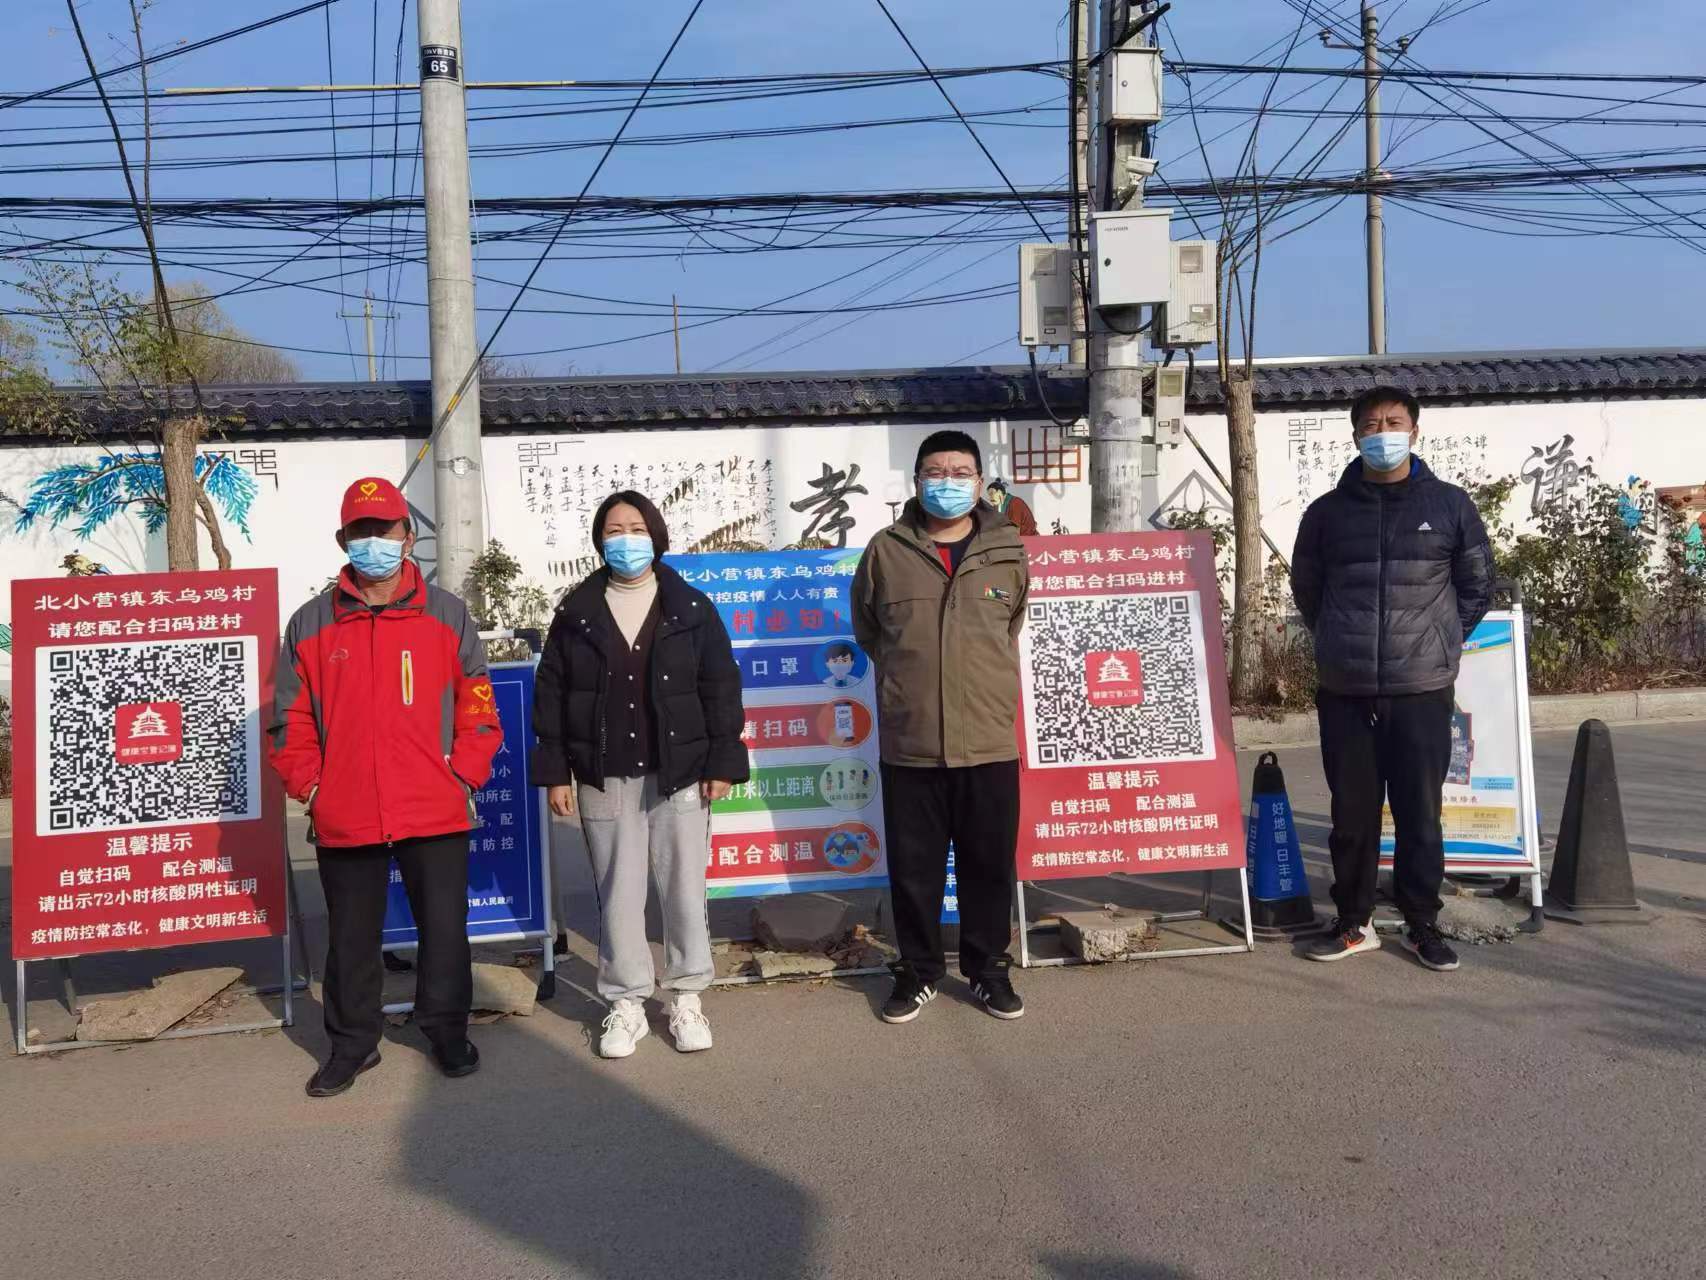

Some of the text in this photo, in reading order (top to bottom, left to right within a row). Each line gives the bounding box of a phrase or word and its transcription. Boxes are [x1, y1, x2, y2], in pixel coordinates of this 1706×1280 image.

[431, 60, 448, 73] 65
[789, 462, 869, 548] 孝
[1028, 544, 1195, 566] 小营镇东乌鸡村
[34, 585, 256, 611] 北小营镇东乌鸡村
[774, 586, 839, 601] 人人有责
[48, 613, 243, 639] 请您配合扫码进村
[737, 657, 800, 677] 口罩
[1087, 769, 1160, 791] 温馨提示
[1050, 793, 1196, 816] 自觉扫码 配合测温
[1035, 814, 1219, 839] 请出示72小时核酸阴性证明
[106, 832, 193, 857] 温馨提示
[59, 857, 234, 887] 自觉扫码 配合测温
[38, 878, 258, 913] 请出示72小时核酸阴性证明
